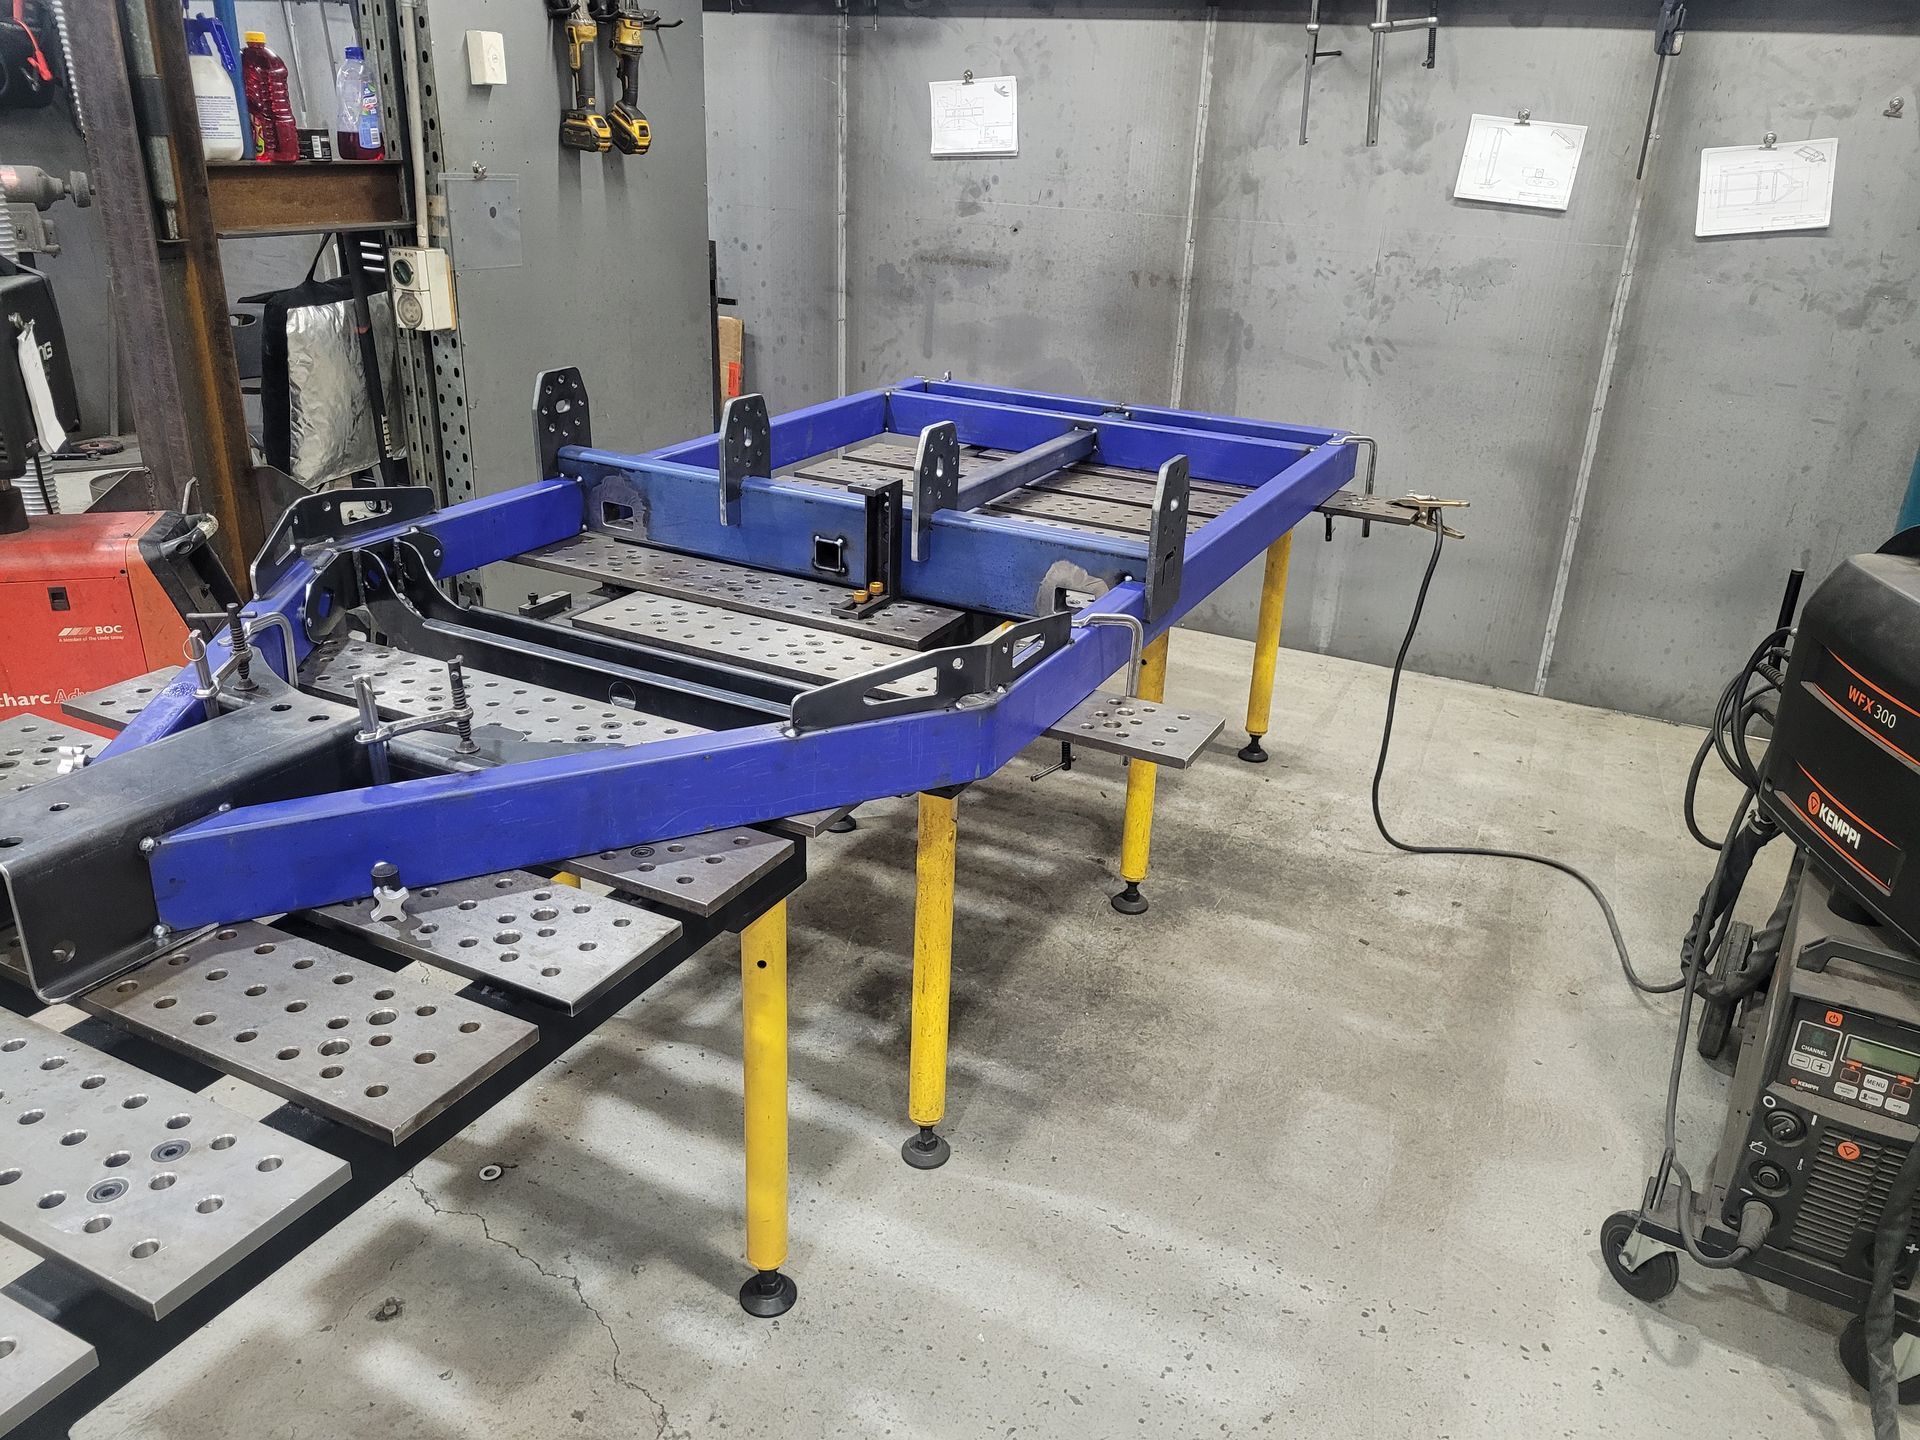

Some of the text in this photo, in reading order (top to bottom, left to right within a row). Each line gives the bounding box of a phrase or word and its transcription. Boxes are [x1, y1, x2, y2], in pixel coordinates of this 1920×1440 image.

[95, 625, 123, 634] BOC
[1849, 685, 1897, 729] WFX 300
[1819, 803, 1862, 850] KEMPPI
[1801, 1044, 1828, 1057] CHANNEL
[1866, 1078, 1886, 1089] MENU
